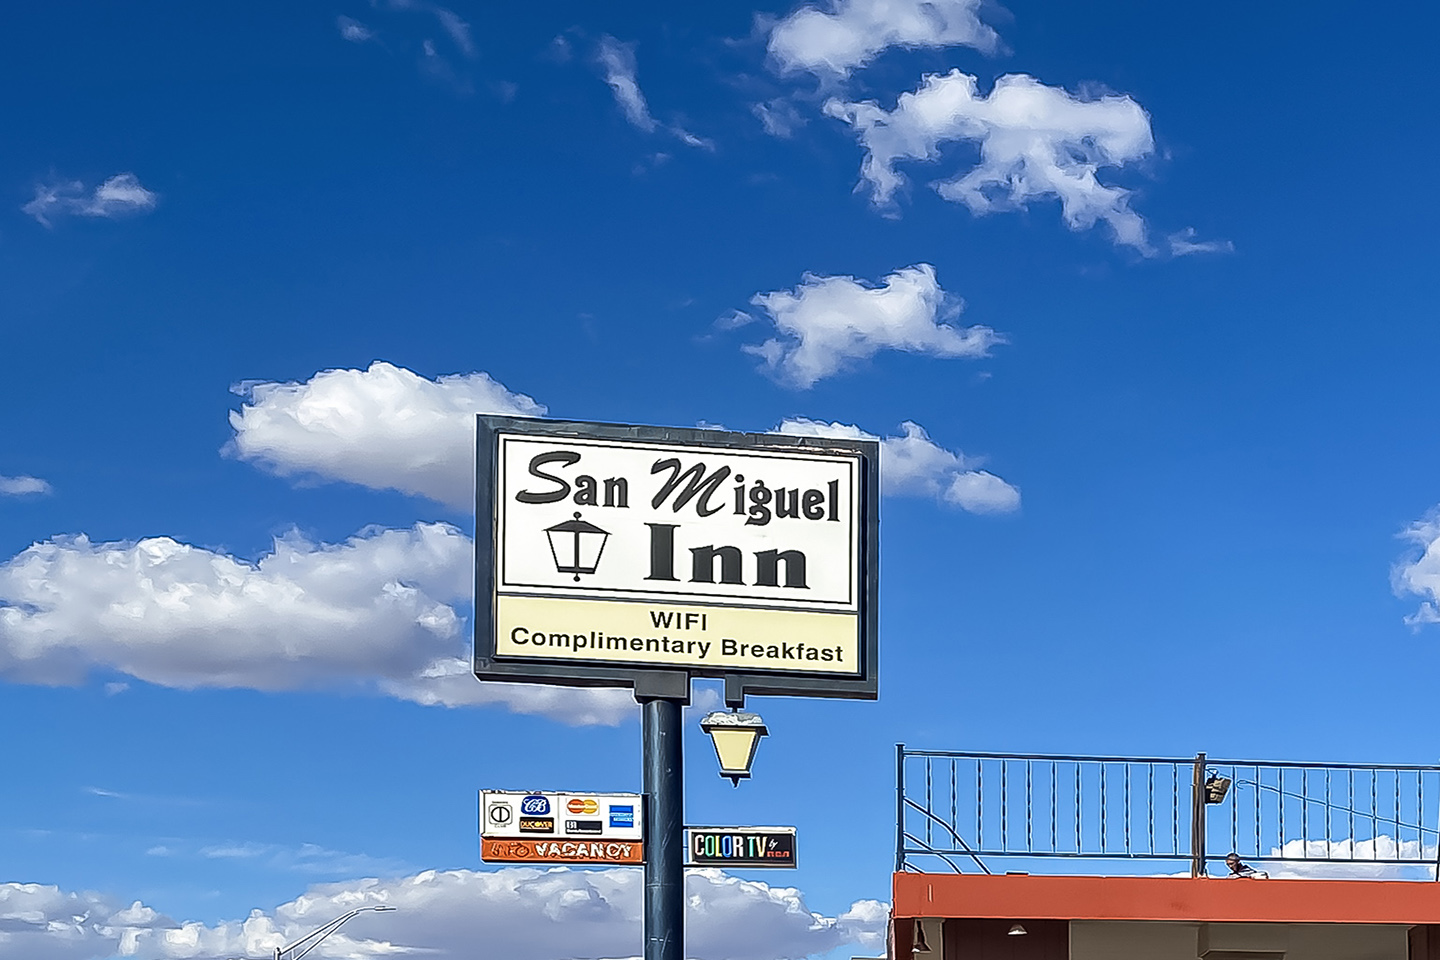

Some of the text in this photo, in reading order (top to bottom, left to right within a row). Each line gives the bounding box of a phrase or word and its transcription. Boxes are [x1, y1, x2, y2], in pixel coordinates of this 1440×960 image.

[515, 450, 841, 526] San Miguel
[643, 522, 811, 590] Inn
[650, 610, 708, 632] WIFI
[510, 627, 844, 663] Complimentary Breakfast
[535, 842, 633, 859] VACANCY
[694, 834, 744, 858] COLOR
[747, 836, 768, 858] TV
